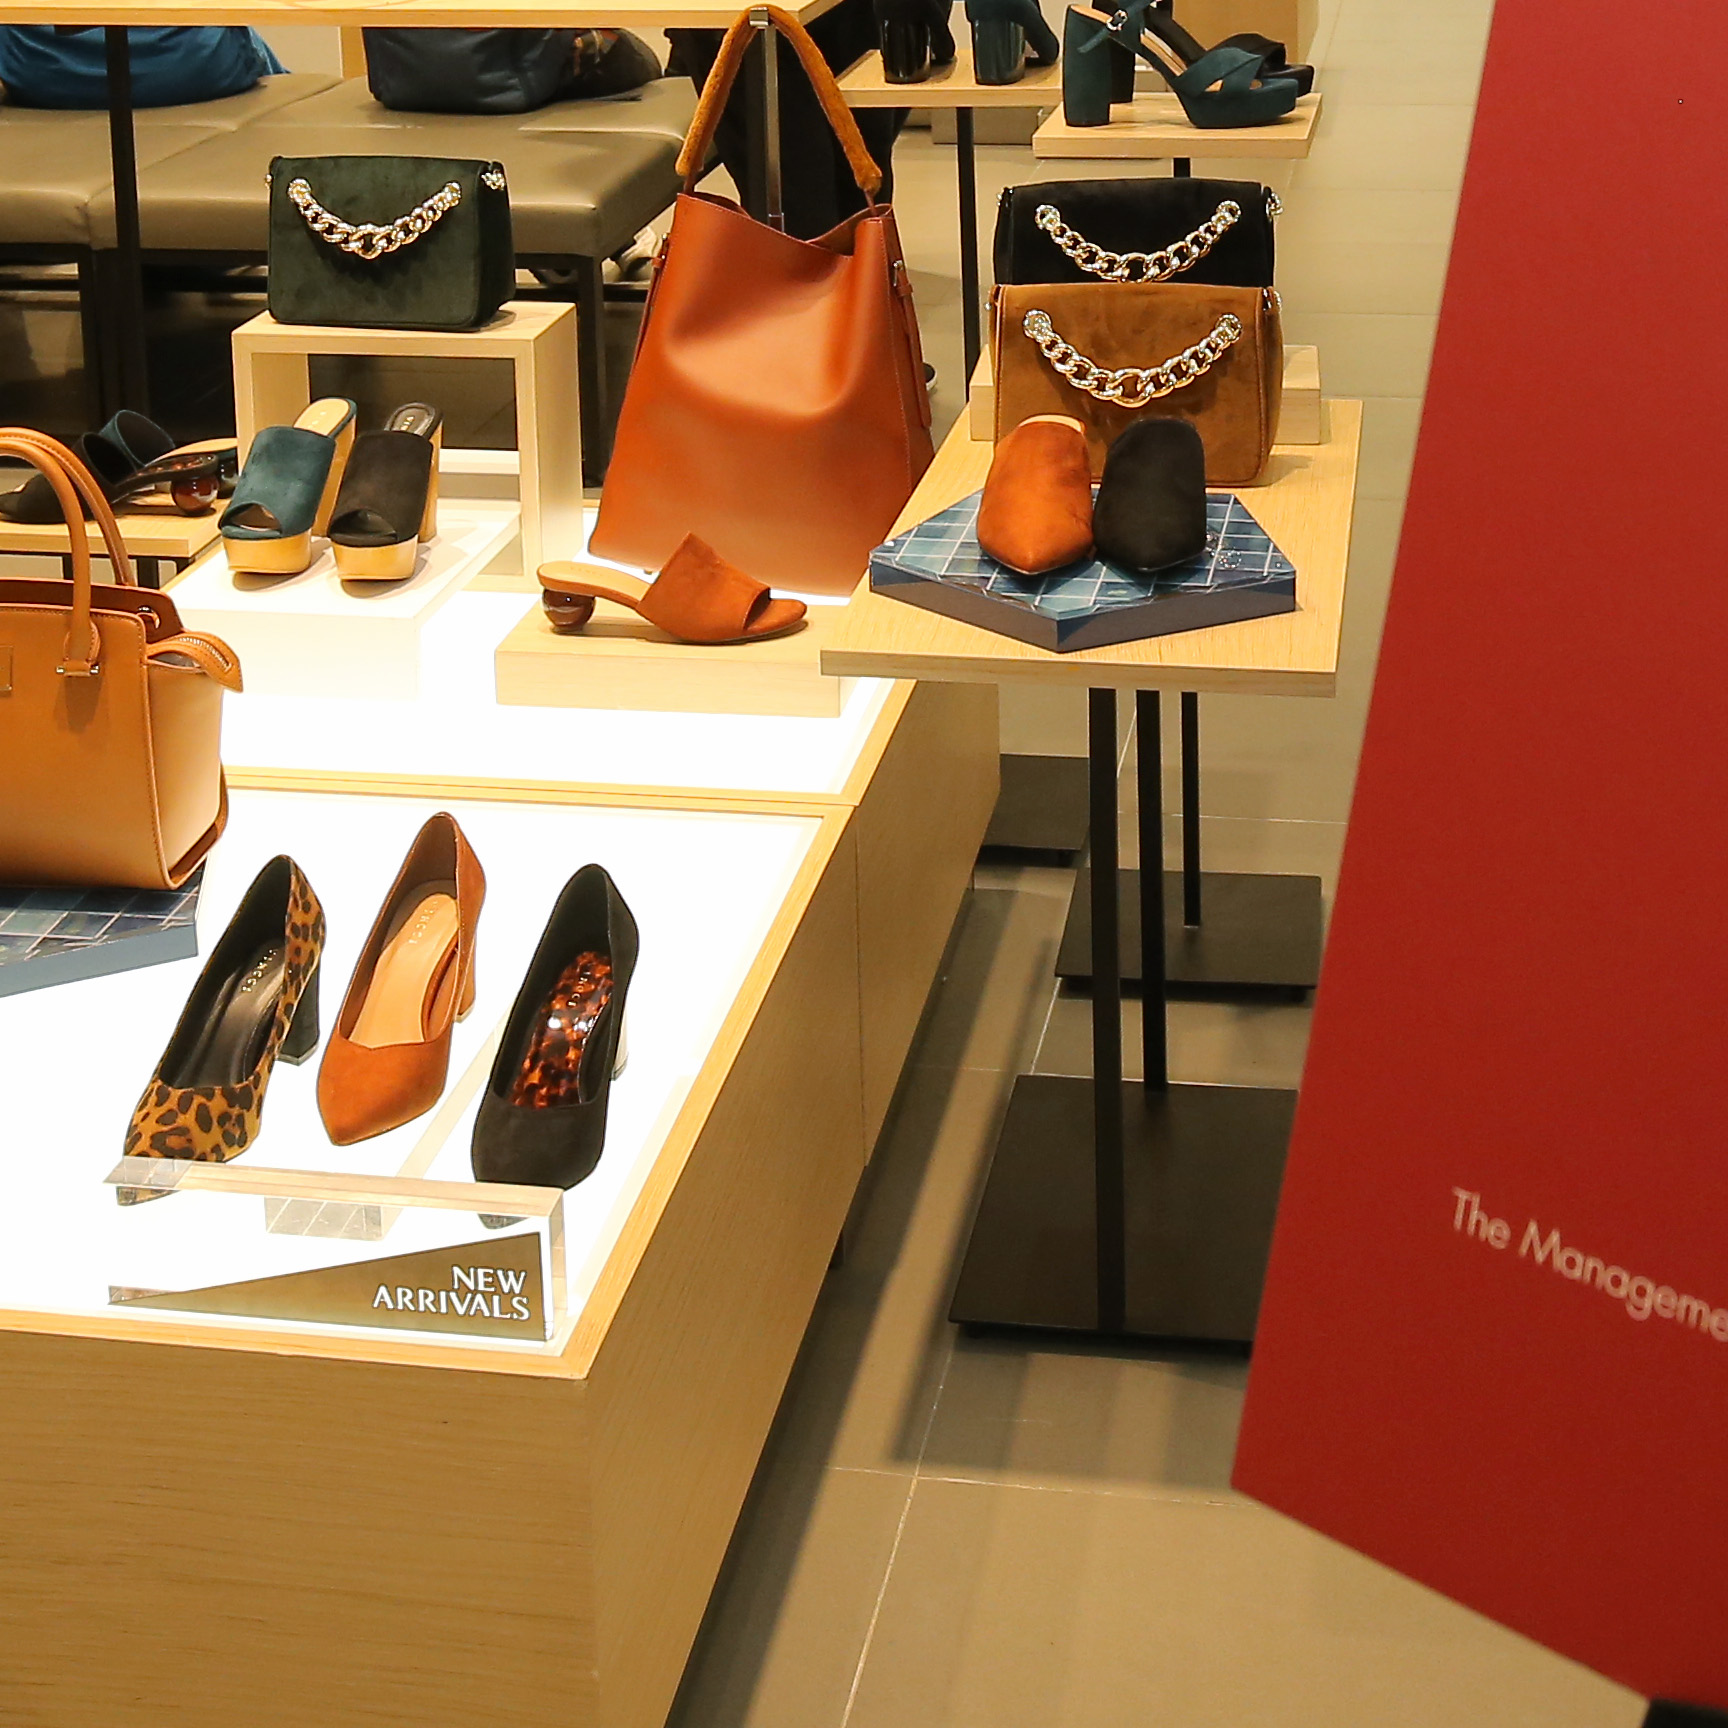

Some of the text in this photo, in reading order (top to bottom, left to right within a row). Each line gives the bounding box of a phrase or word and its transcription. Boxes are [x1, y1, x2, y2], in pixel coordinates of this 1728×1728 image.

[1452, 1186, 1512, 1249] The
[451, 1265, 528, 1294] NEW
[372, 1284, 531, 1322] ARRIVALS
